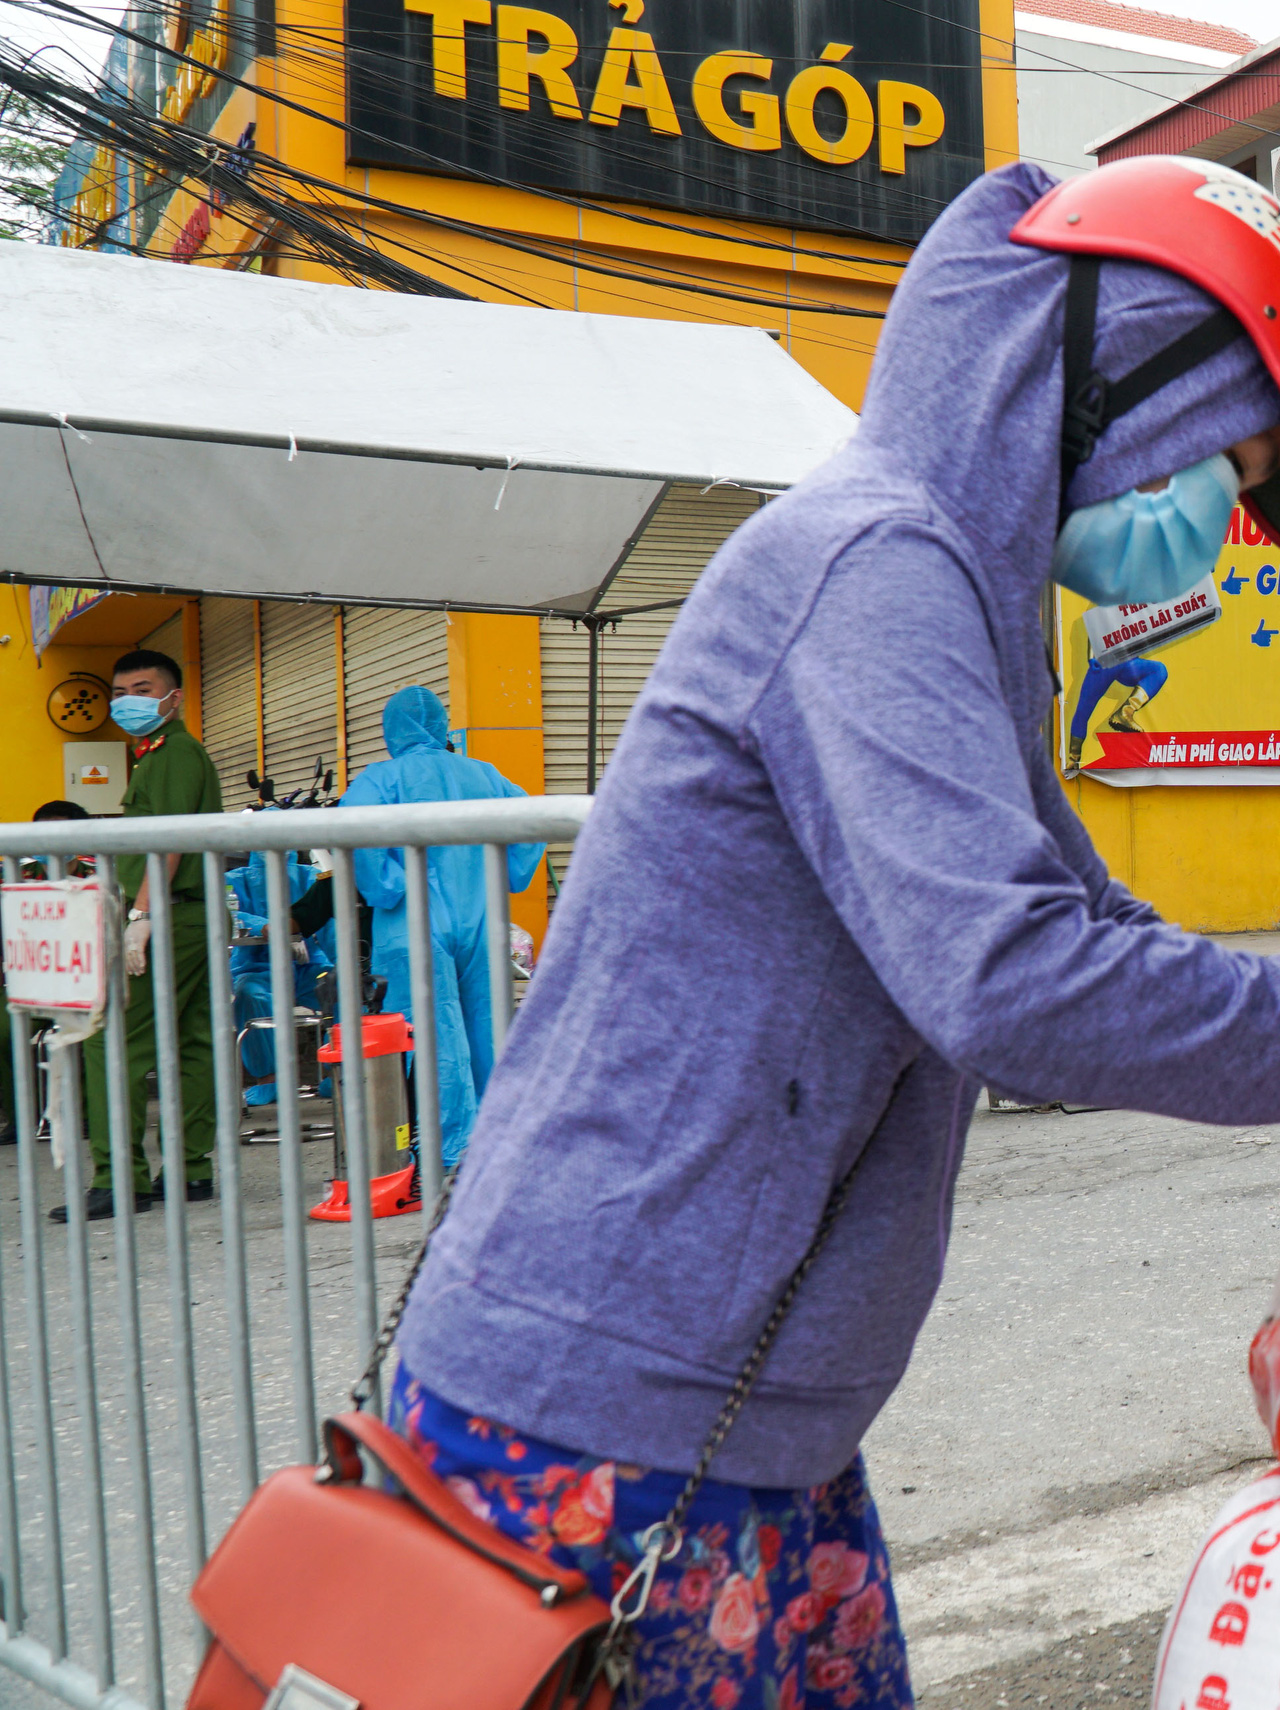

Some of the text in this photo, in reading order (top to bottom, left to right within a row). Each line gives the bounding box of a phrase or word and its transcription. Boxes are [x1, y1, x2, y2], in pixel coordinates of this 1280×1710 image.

[405, 0, 945, 174] TRẢ GÓP
[1102, 592, 1207, 649] KHÔNG LÃI SUẤT
[1149, 736, 1187, 762] MIỄN
[1190, 738, 1214, 762] PHÍ
[1218, 743, 1252, 761] GIAO
[6, 928, 92, 984] DỪNG LẠI
